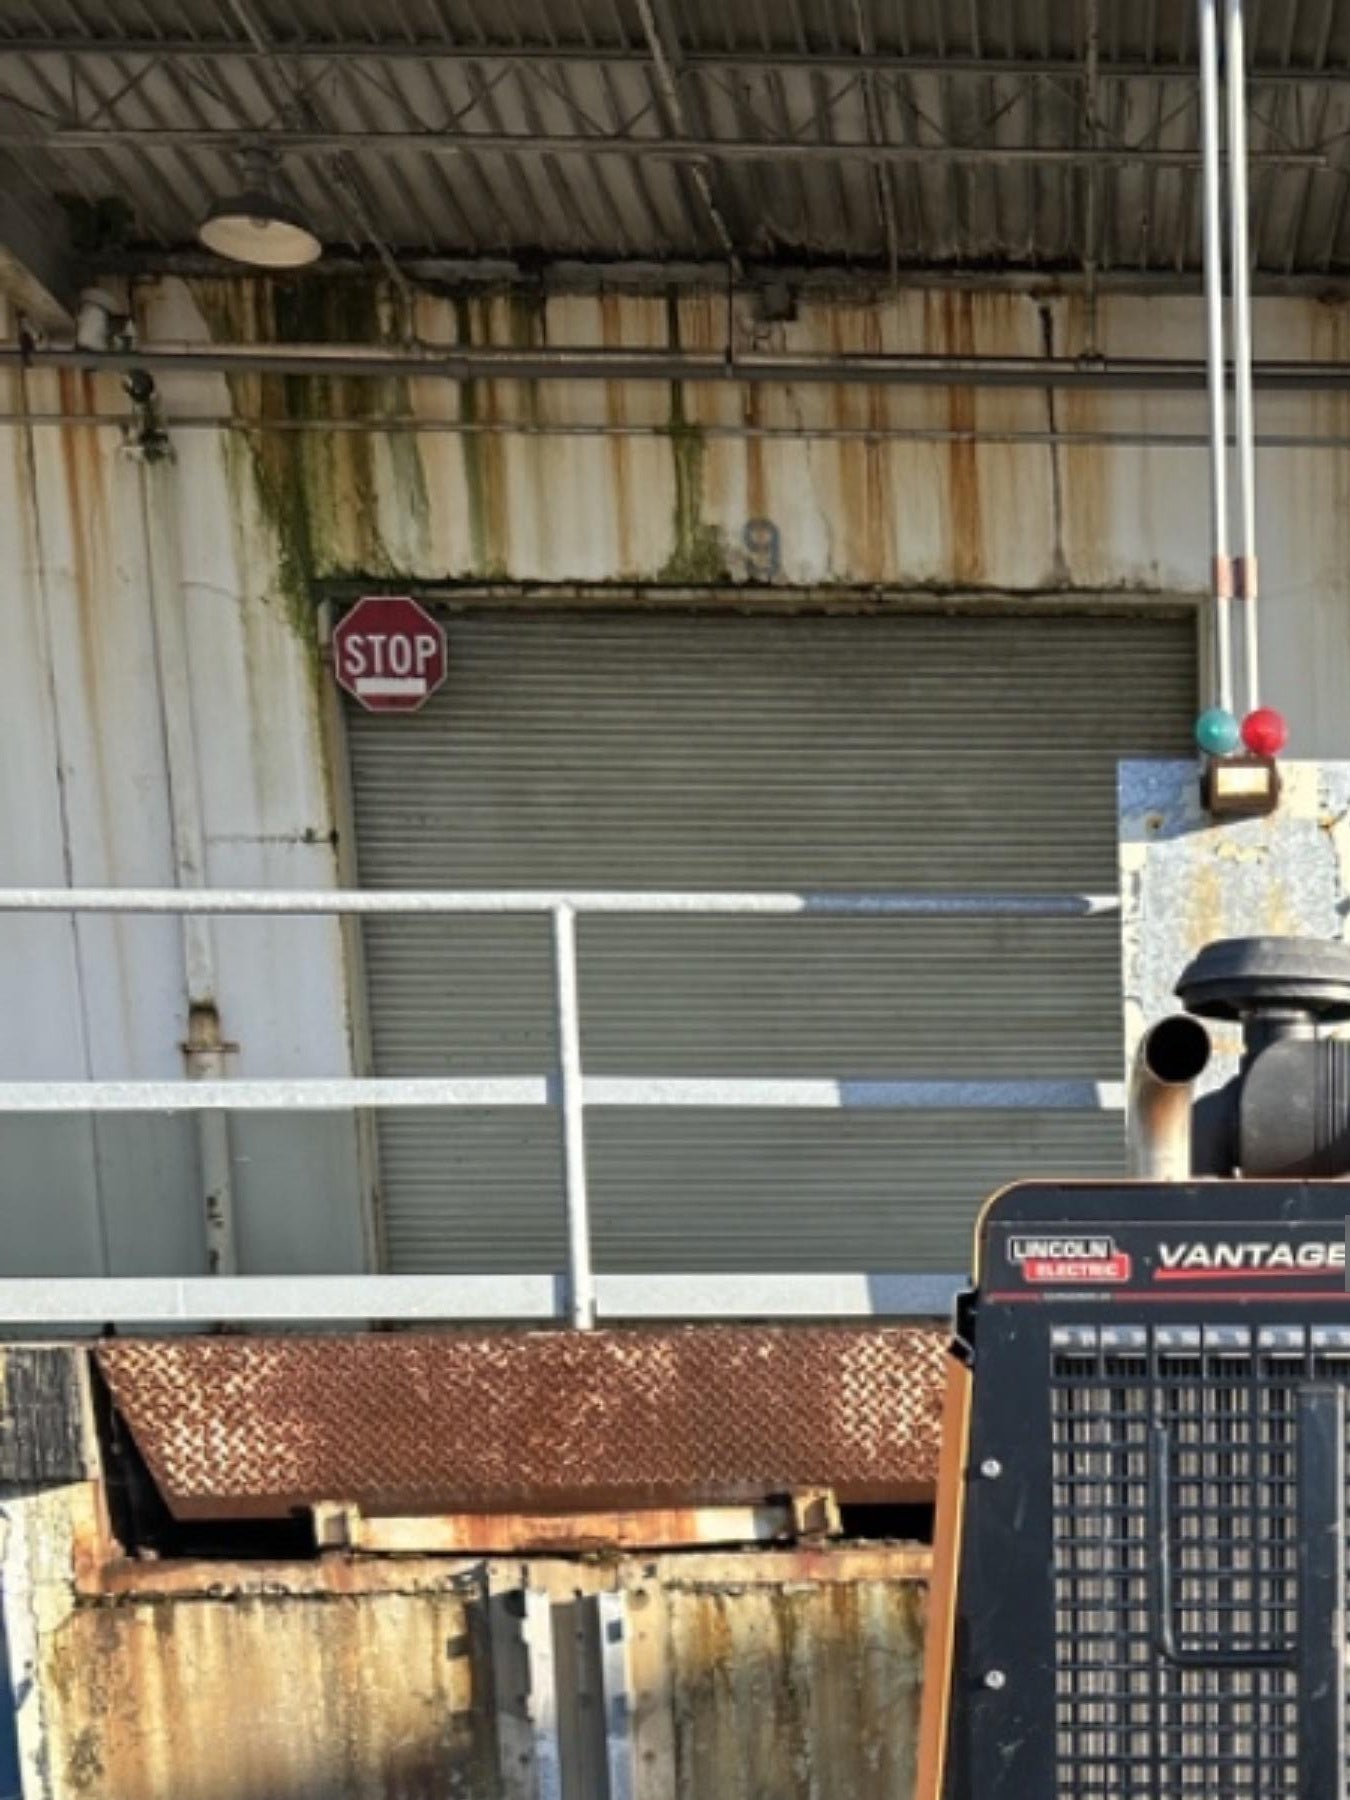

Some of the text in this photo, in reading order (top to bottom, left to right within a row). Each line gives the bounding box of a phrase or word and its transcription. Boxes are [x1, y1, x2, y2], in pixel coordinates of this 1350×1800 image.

[742, 518, 780, 577] 9
[345, 634, 437, 675] STOP
[1014, 1240, 1108, 1258] LINCOLN
[1157, 1241, 1345, 1268] VANTAGE
[1036, 1262, 1118, 1276] ELECTRIC
